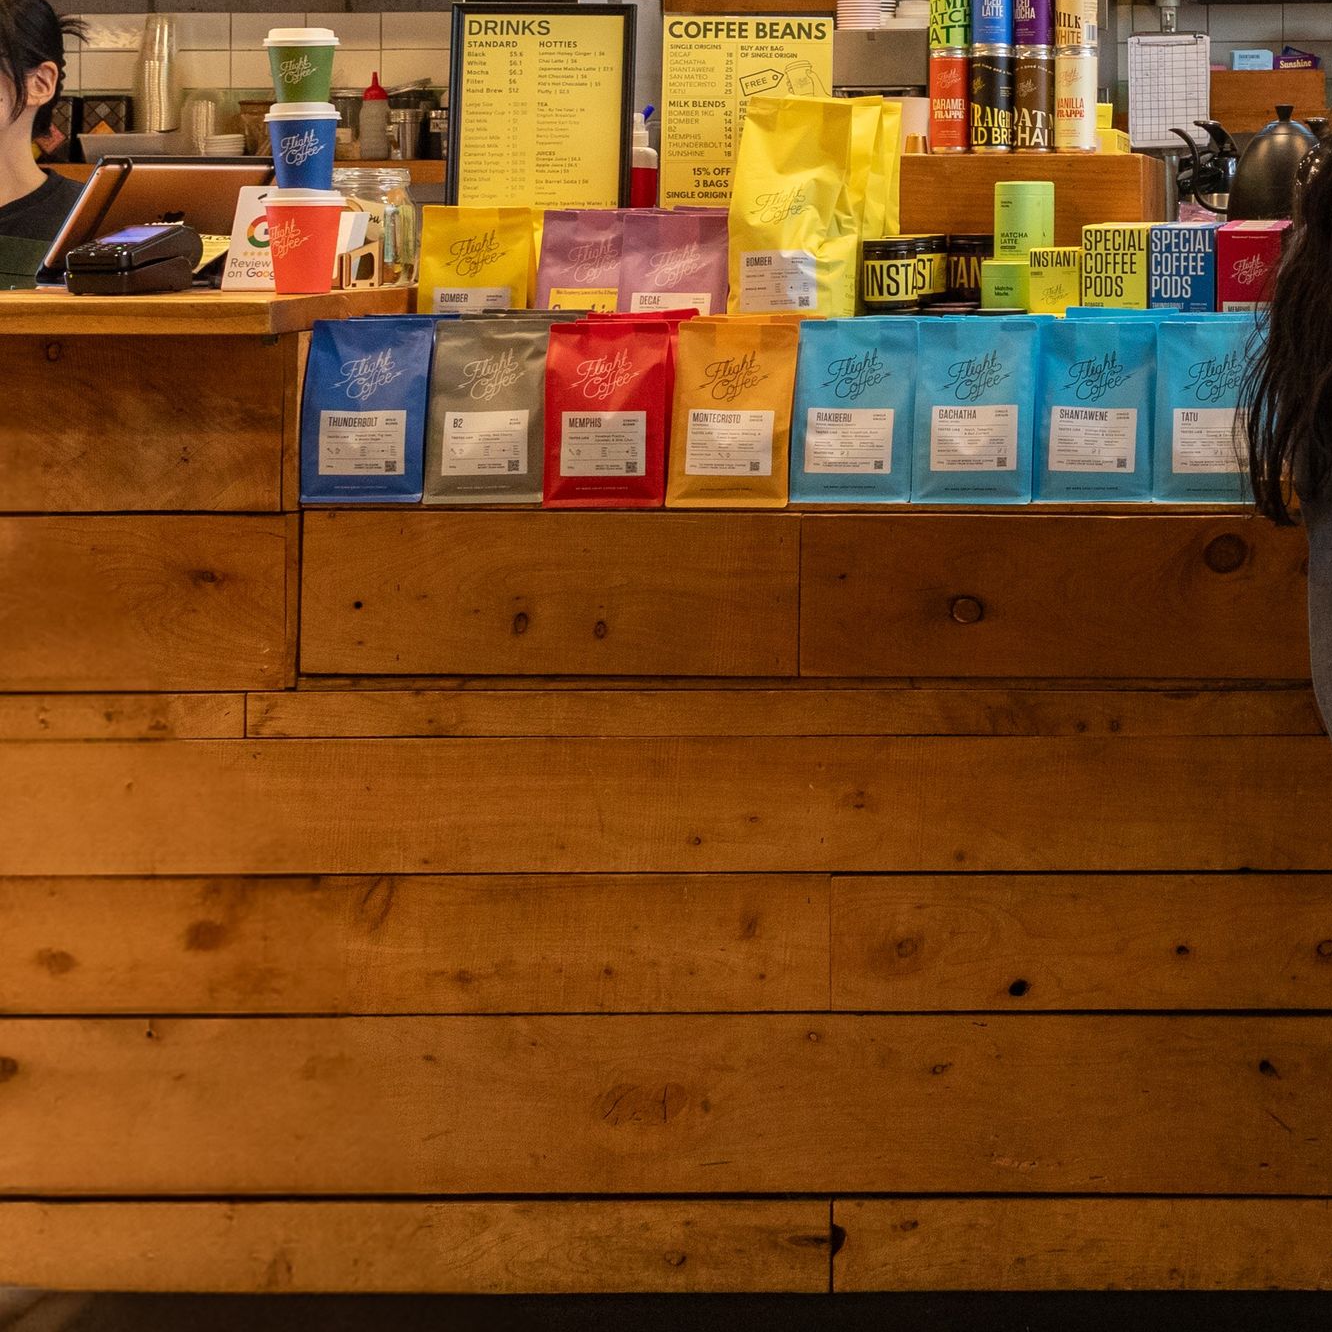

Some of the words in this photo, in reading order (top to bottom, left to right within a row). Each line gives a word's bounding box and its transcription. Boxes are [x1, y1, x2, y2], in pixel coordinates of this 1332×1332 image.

[982, 6, 1003, 17] LATTE
[468, 20, 550, 35] DRINKS
[669, 21, 748, 38] COFFEE
[756, 22, 826, 40] BEANS
[1280, 59, 1311, 68] Sunshine
[745, 77, 768, 89] FREE
[932, 99, 965, 110] CARAMEL
[935, 110, 964, 119] FRAPPE
[1057, 98, 1084, 109] VANILLA
[1057, 110, 1084, 118] FRAPPE
[280, 129, 318, 155] Flight
[286, 144, 324, 165] Coffee
[449, 230, 499, 264] Flight
[1084, 229, 1144, 252] SPECIAL
[1151, 230, 1212, 252] SPECIAL
[230, 258, 271, 268] Review
[455, 250, 505, 278] Coffee
[746, 257, 772, 267] BOMBER
[1030, 251, 1077, 267] INSTANT
[1084, 253, 1137, 275] COFFEE
[1152, 253, 1205, 275] COFFEE
[440, 293, 468, 303] BOMBER
[1084, 276, 1123, 298] PODS
[1152, 276, 1191, 298] PODS
[640, 296, 661, 305] DECAF
[335, 348, 395, 383] Flight
[460, 348, 518, 382] Flight
[573, 348, 632, 383] Flight
[702, 351, 760, 385] Flight
[825, 348, 883, 383] Flight
[946, 350, 1002, 385] Flight
[1066, 351, 1123, 385] Flight
[1186, 351, 1242, 386] Flight
[346, 370, 402, 400] Coffee
[471, 370, 524, 400] Coffee
[584, 370, 639, 400] Coffee
[712, 373, 768, 402] Coffee
[835, 370, 890, 400] Coffee
[955, 371, 1010, 402] Coffee
[1076, 373, 1131, 402] Coffee
[1196, 373, 1242, 403] Coffee
[329, 417, 377, 427] THUNDERBOLT
[453, 419, 463, 428] B2
[569, 418, 601, 428] MEMPHIS
[692, 413, 741, 423] MONTECRISTO
[939, 409, 976, 419] GACHATHA
[1060, 409, 1108, 421] SHANTAWENE
[1181, 412, 1198, 422] TATU
